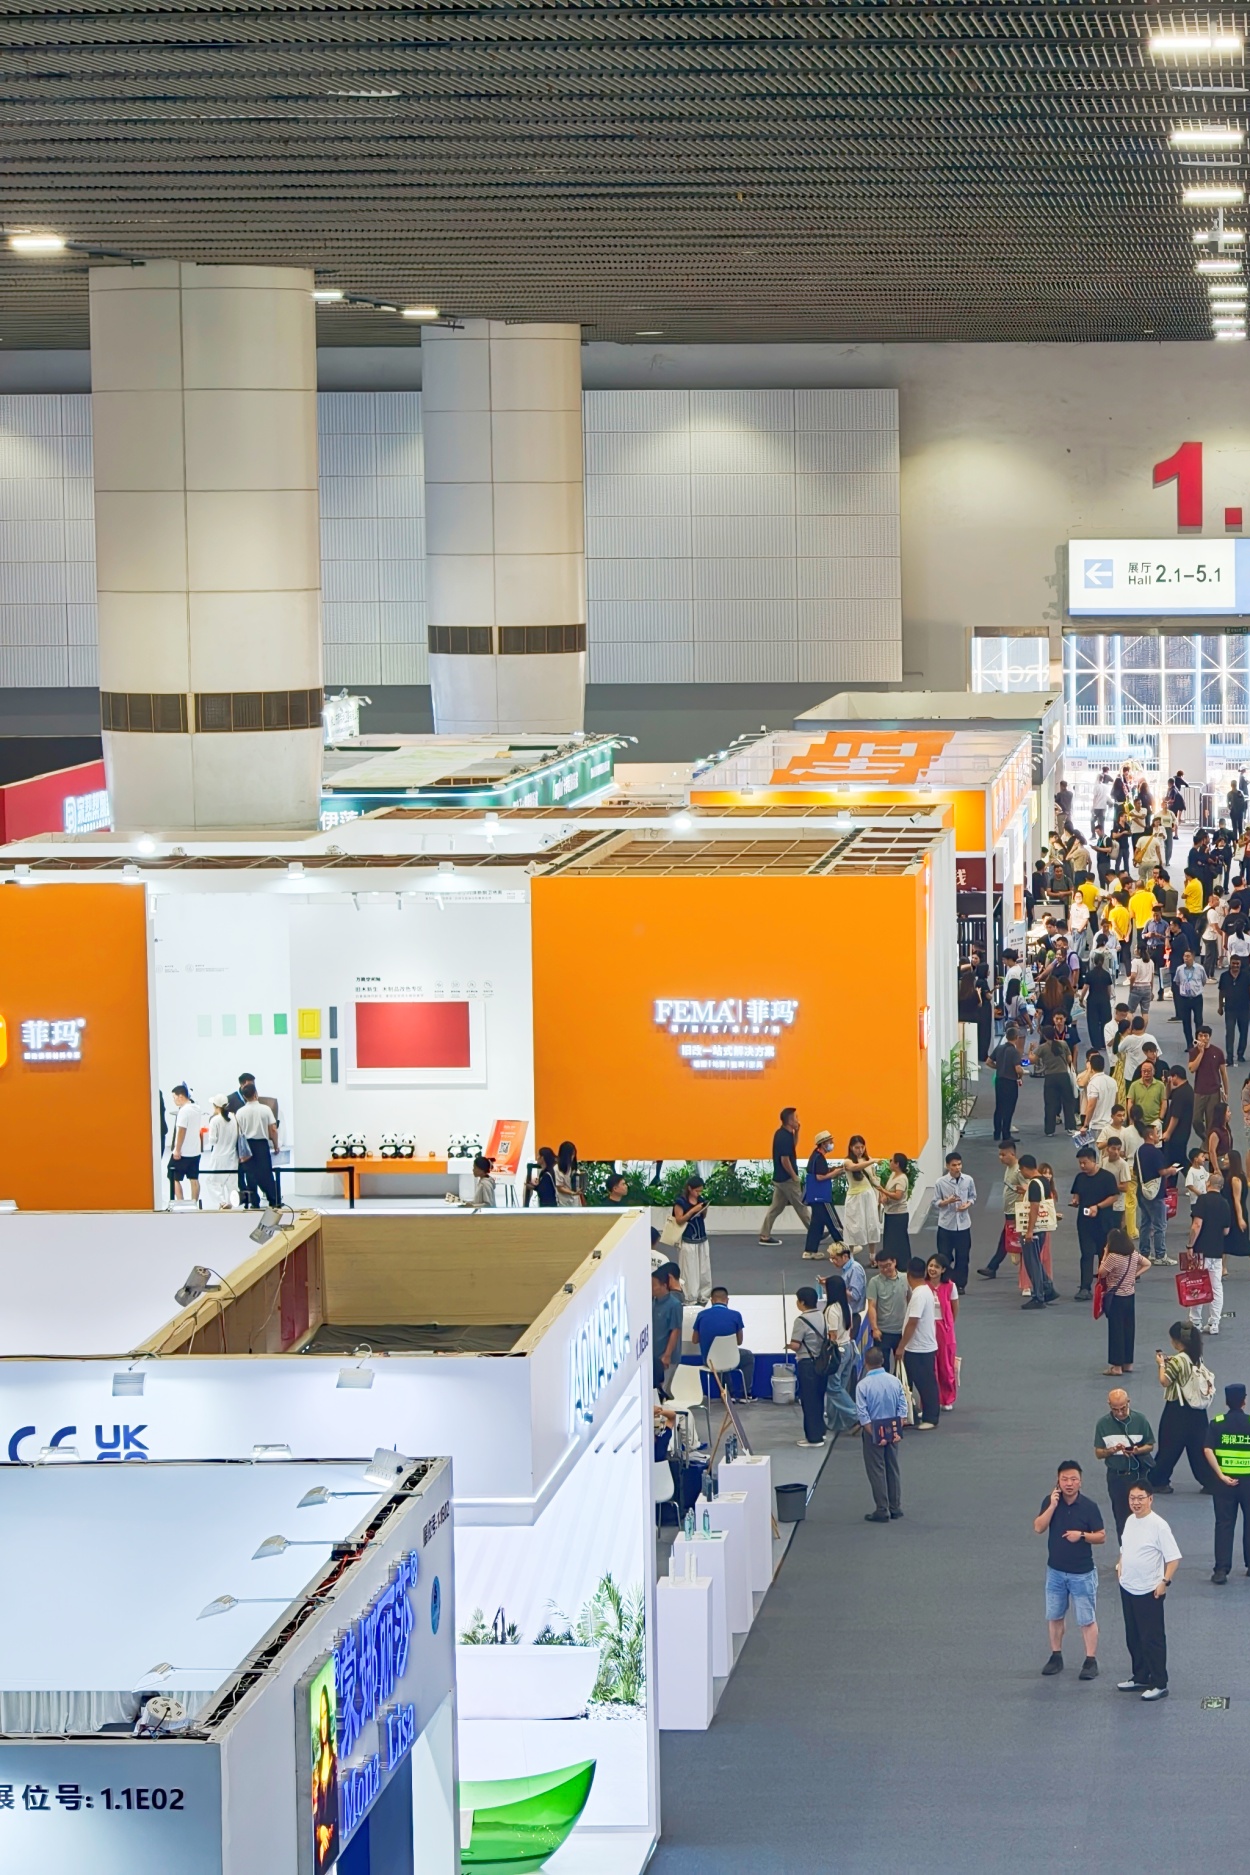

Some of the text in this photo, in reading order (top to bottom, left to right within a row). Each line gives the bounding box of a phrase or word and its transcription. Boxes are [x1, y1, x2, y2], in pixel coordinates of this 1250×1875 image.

[1128, 562, 1151, 573] 展厅
[1128, 575, 1151, 585] Hall
[654, 999, 798, 1024] FEMA 菲玛
[21, 1019, 86, 1049] 菲玛
[95, 1424, 150, 1450] UK
[343, 1703, 415, 1840] Mona Lisa
[101, 1787, 184, 1811] 1.1E02
